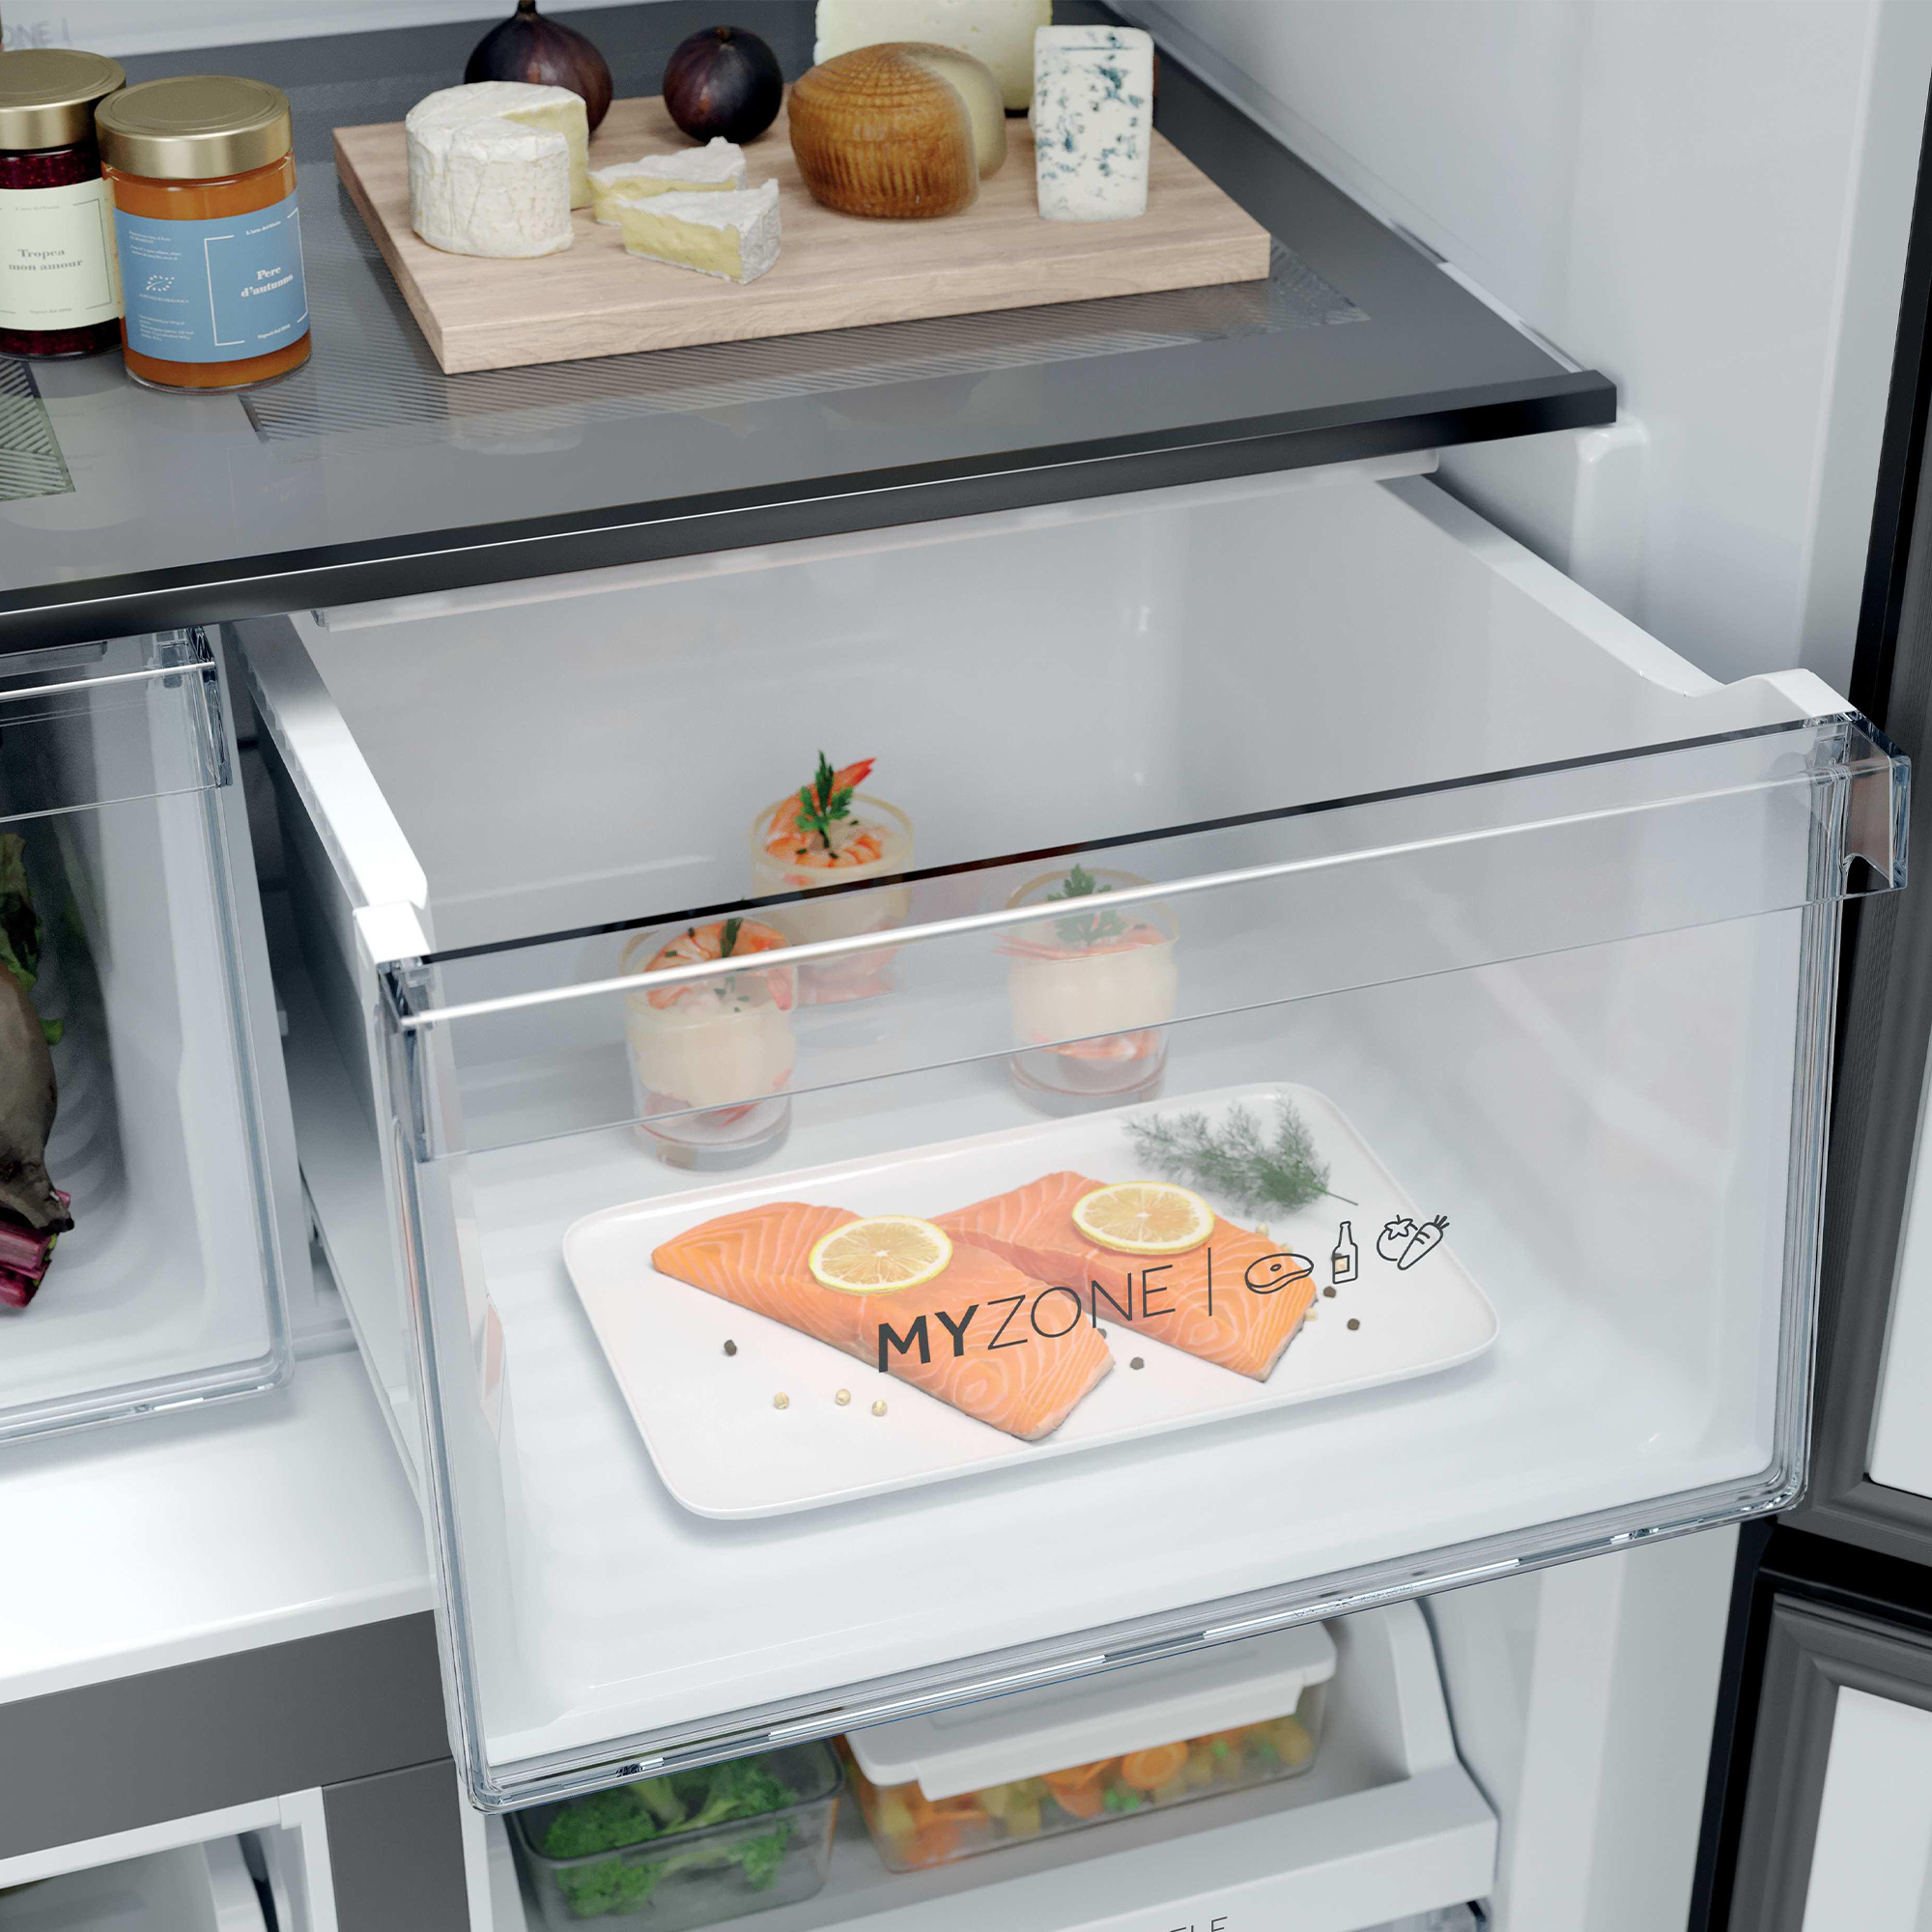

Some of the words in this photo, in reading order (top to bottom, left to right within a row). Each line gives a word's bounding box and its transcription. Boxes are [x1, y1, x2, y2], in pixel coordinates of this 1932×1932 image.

[17, 248, 66, 260] Tropea
[40, 260, 83, 270] amour
[256, 267, 281, 281] Pere
[877, 1264, 1177, 1374] MYZONE
